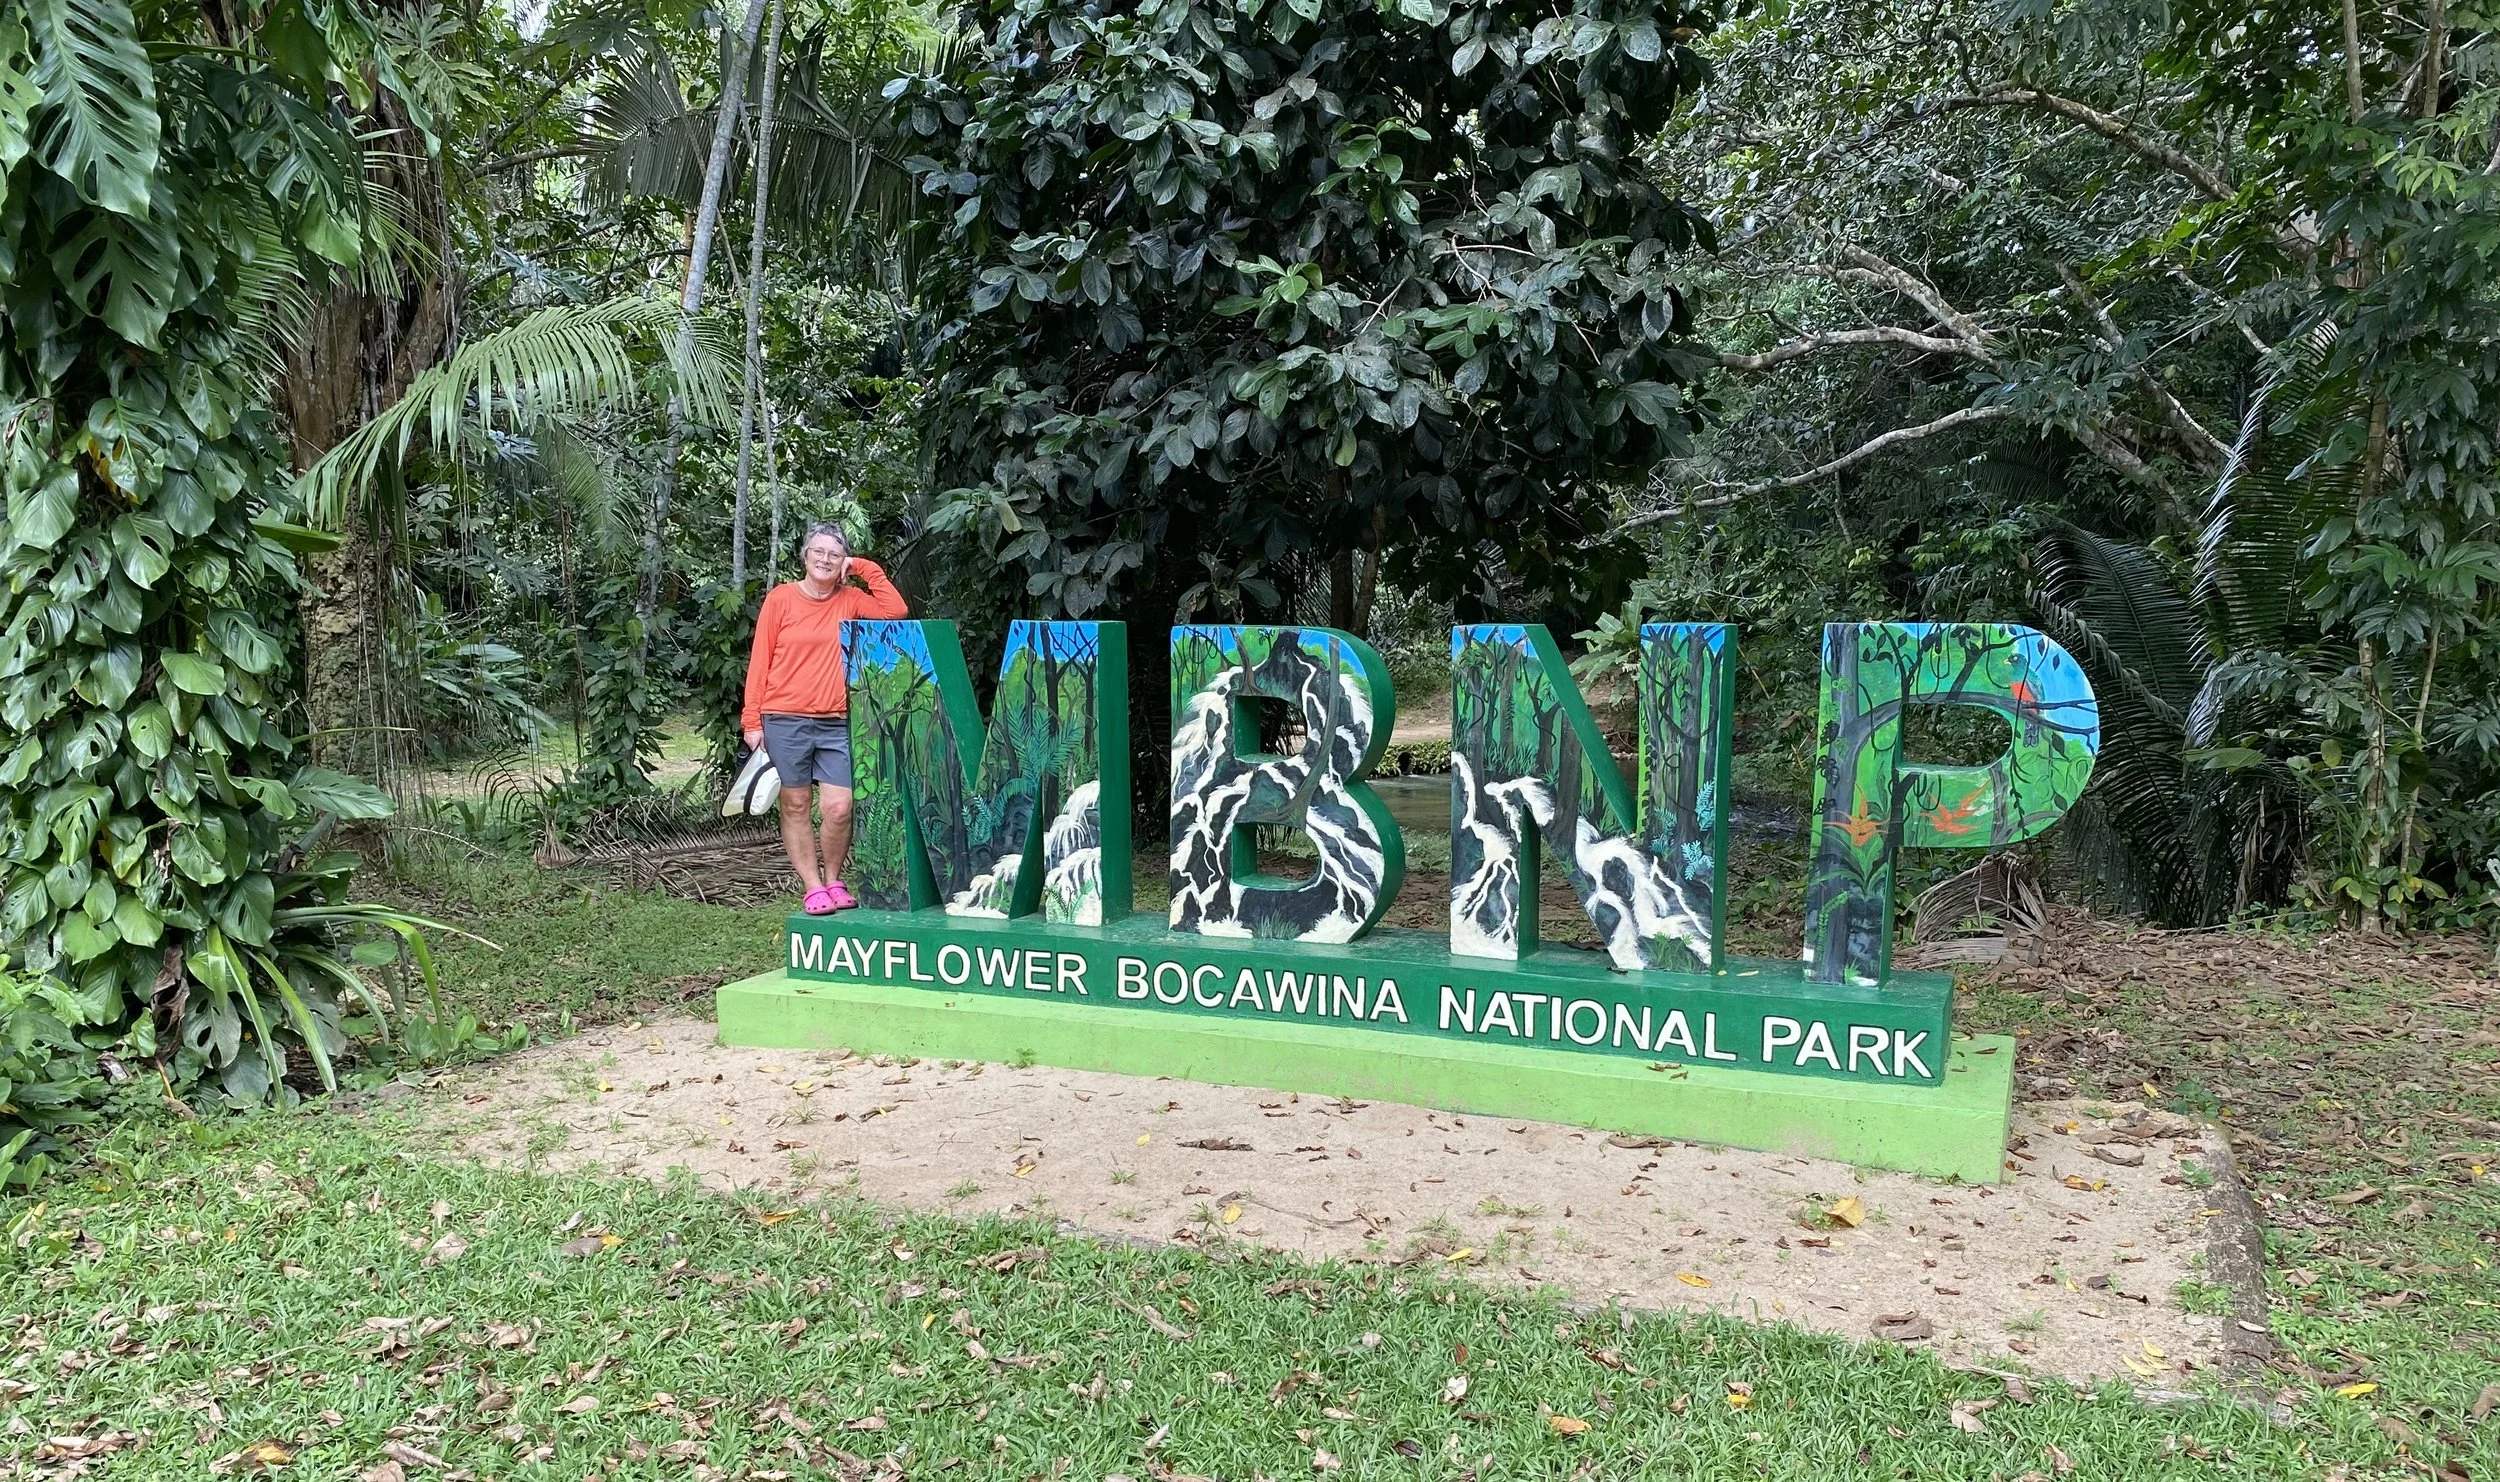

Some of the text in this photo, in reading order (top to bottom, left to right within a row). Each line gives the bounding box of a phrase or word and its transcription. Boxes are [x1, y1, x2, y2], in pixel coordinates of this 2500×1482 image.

[839, 619, 2100, 990] MBNP
[789, 932, 1934, 1079] MAYFLOWER BOCAWINA NATIONAL PARK
